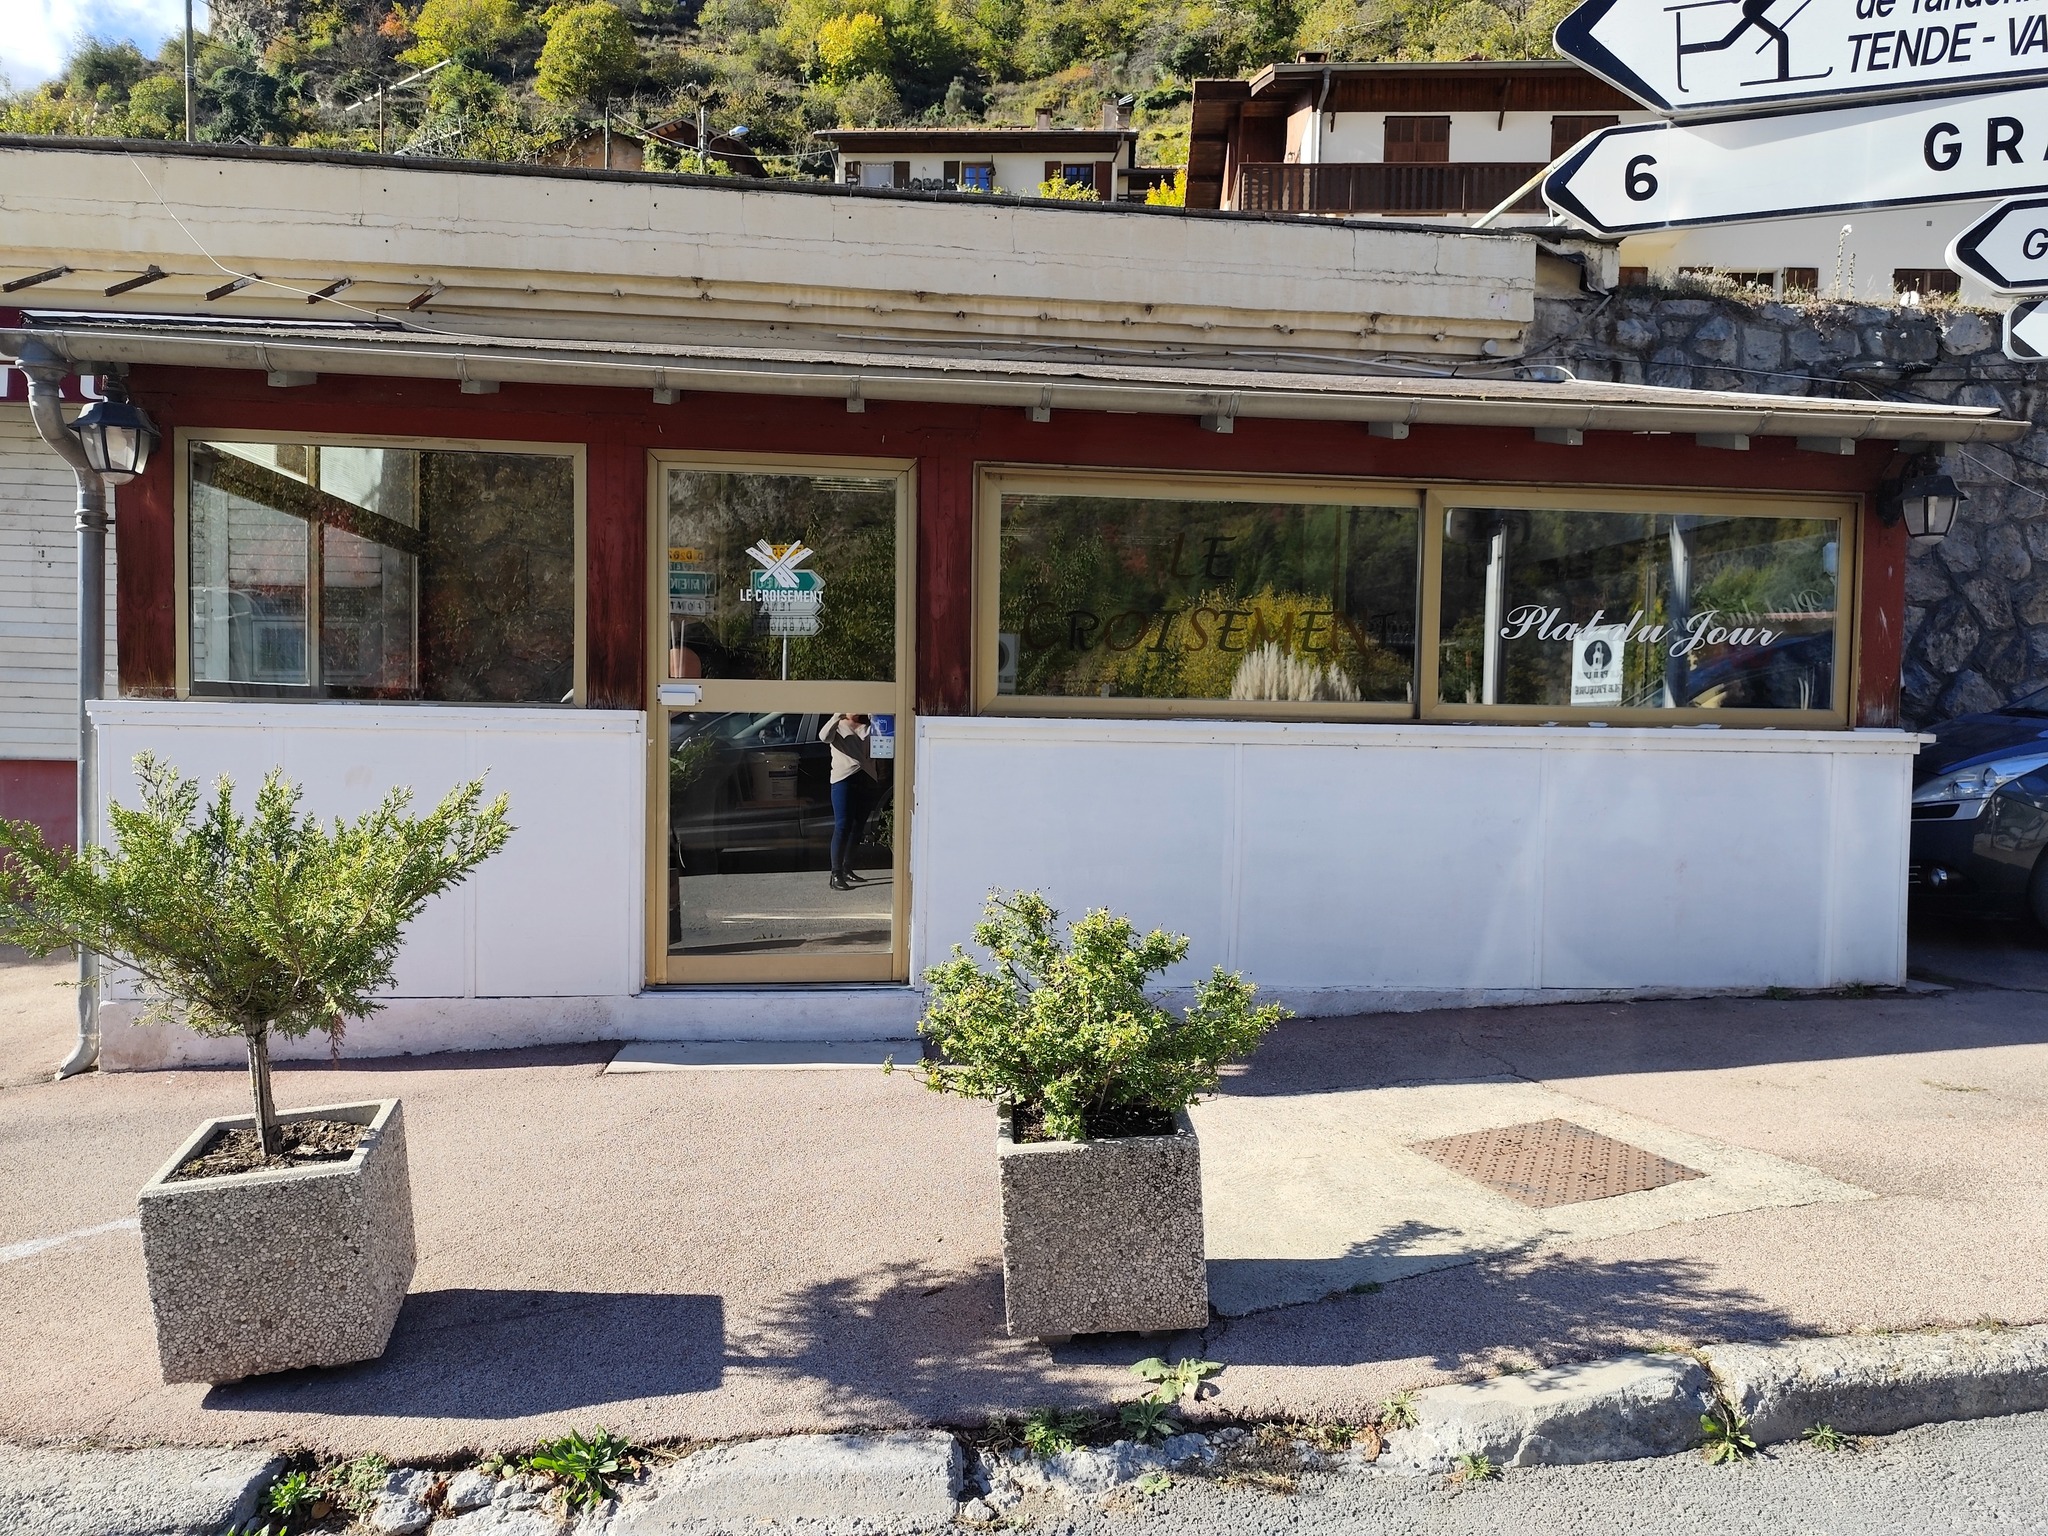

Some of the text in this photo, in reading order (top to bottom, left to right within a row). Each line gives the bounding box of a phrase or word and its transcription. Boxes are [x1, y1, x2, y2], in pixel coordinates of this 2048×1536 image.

[1847, 21, 1977, 73] TENDE
[1625, 154, 1659, 202] 6
[1169, 531, 1237, 580] LE
[740, 588, 823, 603] LE CROISEMENT
[1022, 602, 1398, 656] CROISEMENT
[1499, 604, 1783, 658] Plat du Jour
